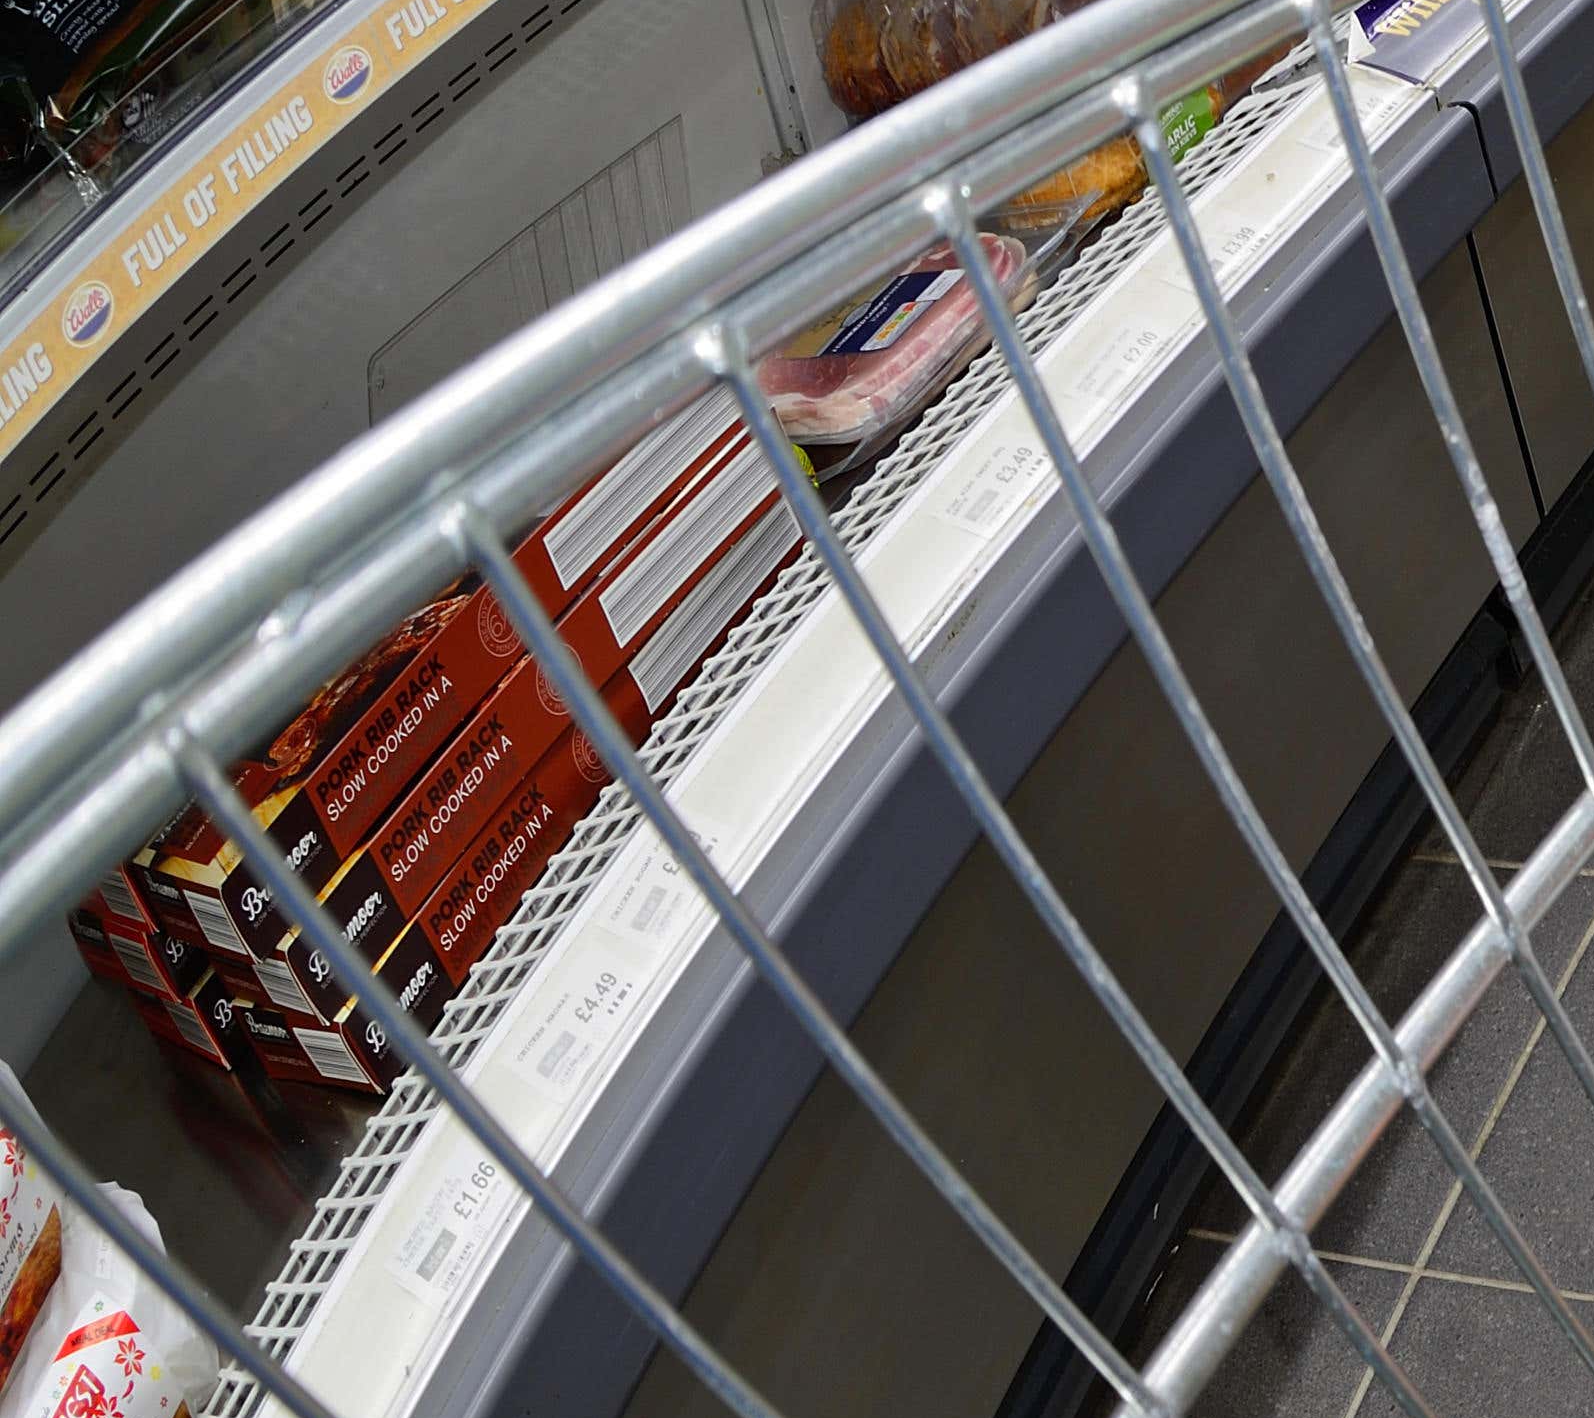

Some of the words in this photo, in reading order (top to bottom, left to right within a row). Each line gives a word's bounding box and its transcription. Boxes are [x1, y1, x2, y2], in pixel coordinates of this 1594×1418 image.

[122, 225, 187, 288] FULL
[183, 175, 220, 229] OF
[220, 96, 314, 195] FILLING
[316, 749, 366, 804] PORK
[365, 707, 398, 753] RIB
[394, 653, 448, 718] RACK
[391, 830, 431, 883] SLOW
[430, 769, 484, 836] COOKED
[482, 752, 498, 772] IN
[499, 734, 514, 752] A
[440, 903, 477, 953] SLOW
[476, 838, 527, 905] COOKED
[526, 819, 542, 840] IN
[539, 802, 555, 820] A
[575, 971, 618, 1023] £4.49
[454, 1159, 496, 1220] £1.66
